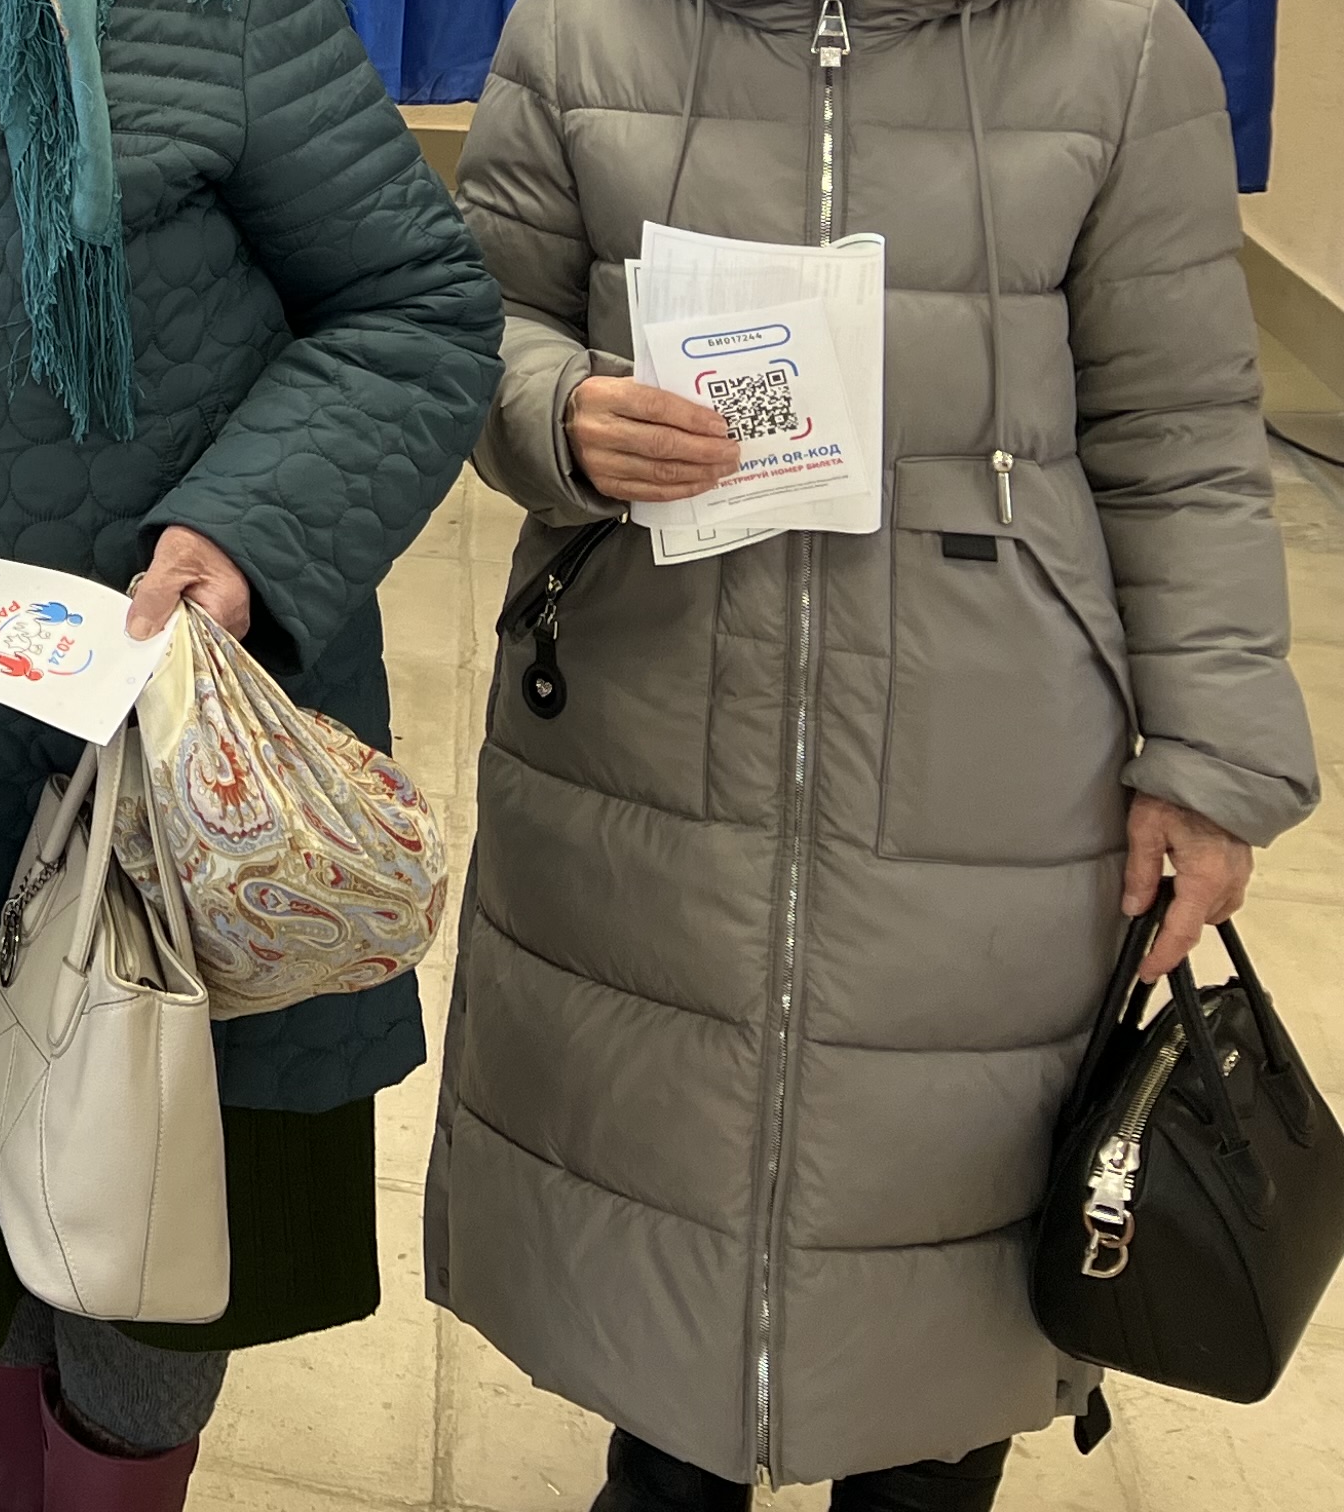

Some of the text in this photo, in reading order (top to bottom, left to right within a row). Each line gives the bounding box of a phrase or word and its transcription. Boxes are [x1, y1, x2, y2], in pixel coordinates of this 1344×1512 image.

[782, 443, 842, 465] QR-КОД
[770, 464, 804, 478] НОМЕР
[806, 457, 844, 472] БИЛЕТА
[47, 635, 75, 666] 2024
